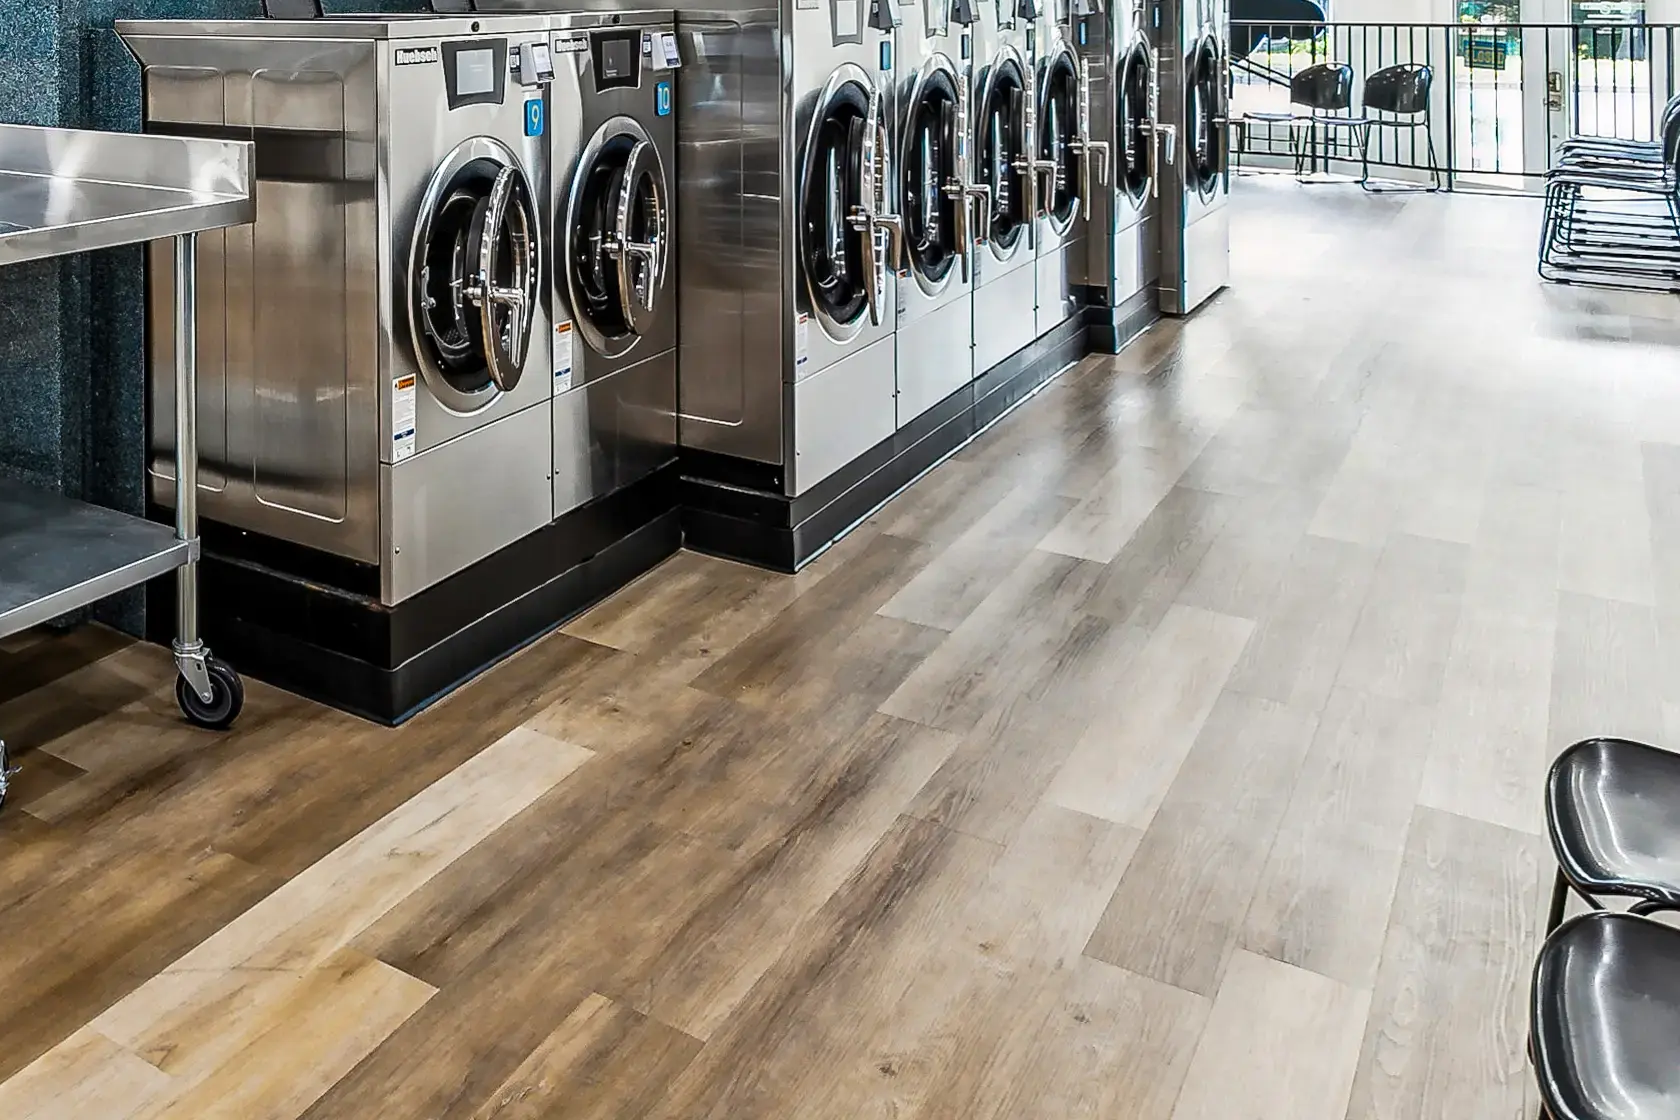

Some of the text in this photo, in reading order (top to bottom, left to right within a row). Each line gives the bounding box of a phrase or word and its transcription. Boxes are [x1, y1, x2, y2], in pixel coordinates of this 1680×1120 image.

[396, 47, 438, 65] Huebsch
[658, 87, 670, 110] 10
[531, 104, 540, 130] 9
